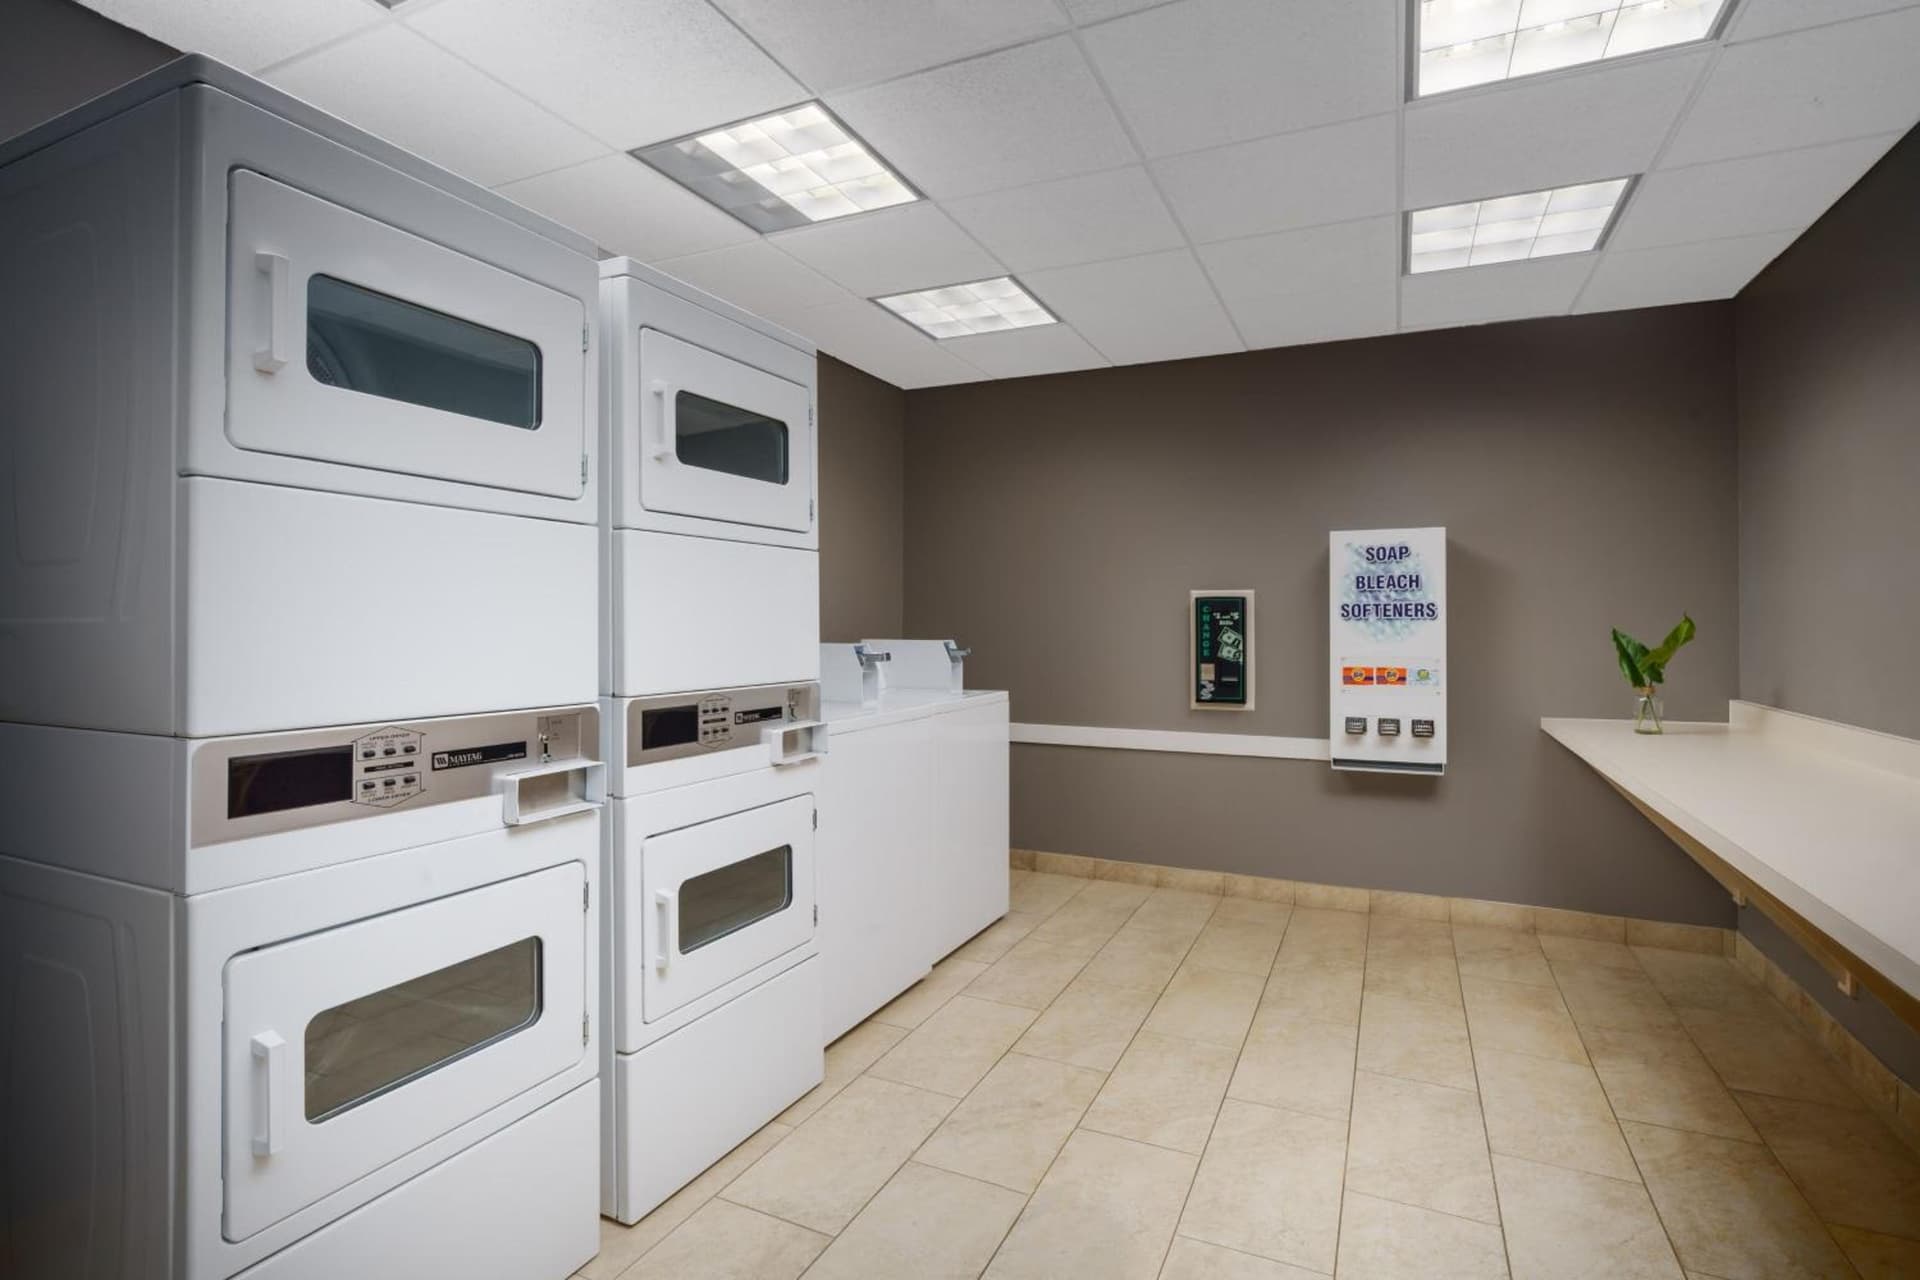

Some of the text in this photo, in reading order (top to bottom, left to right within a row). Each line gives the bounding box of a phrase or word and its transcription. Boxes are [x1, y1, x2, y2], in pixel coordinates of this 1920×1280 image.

[1365, 545, 1411, 563] SOAP
[1356, 574, 1421, 592] BLEACH
[1340, 602, 1438, 620] SOFTENERS
[1202, 605, 1211, 657] CHANGE
[448, 752, 482, 764] MAYTAG
